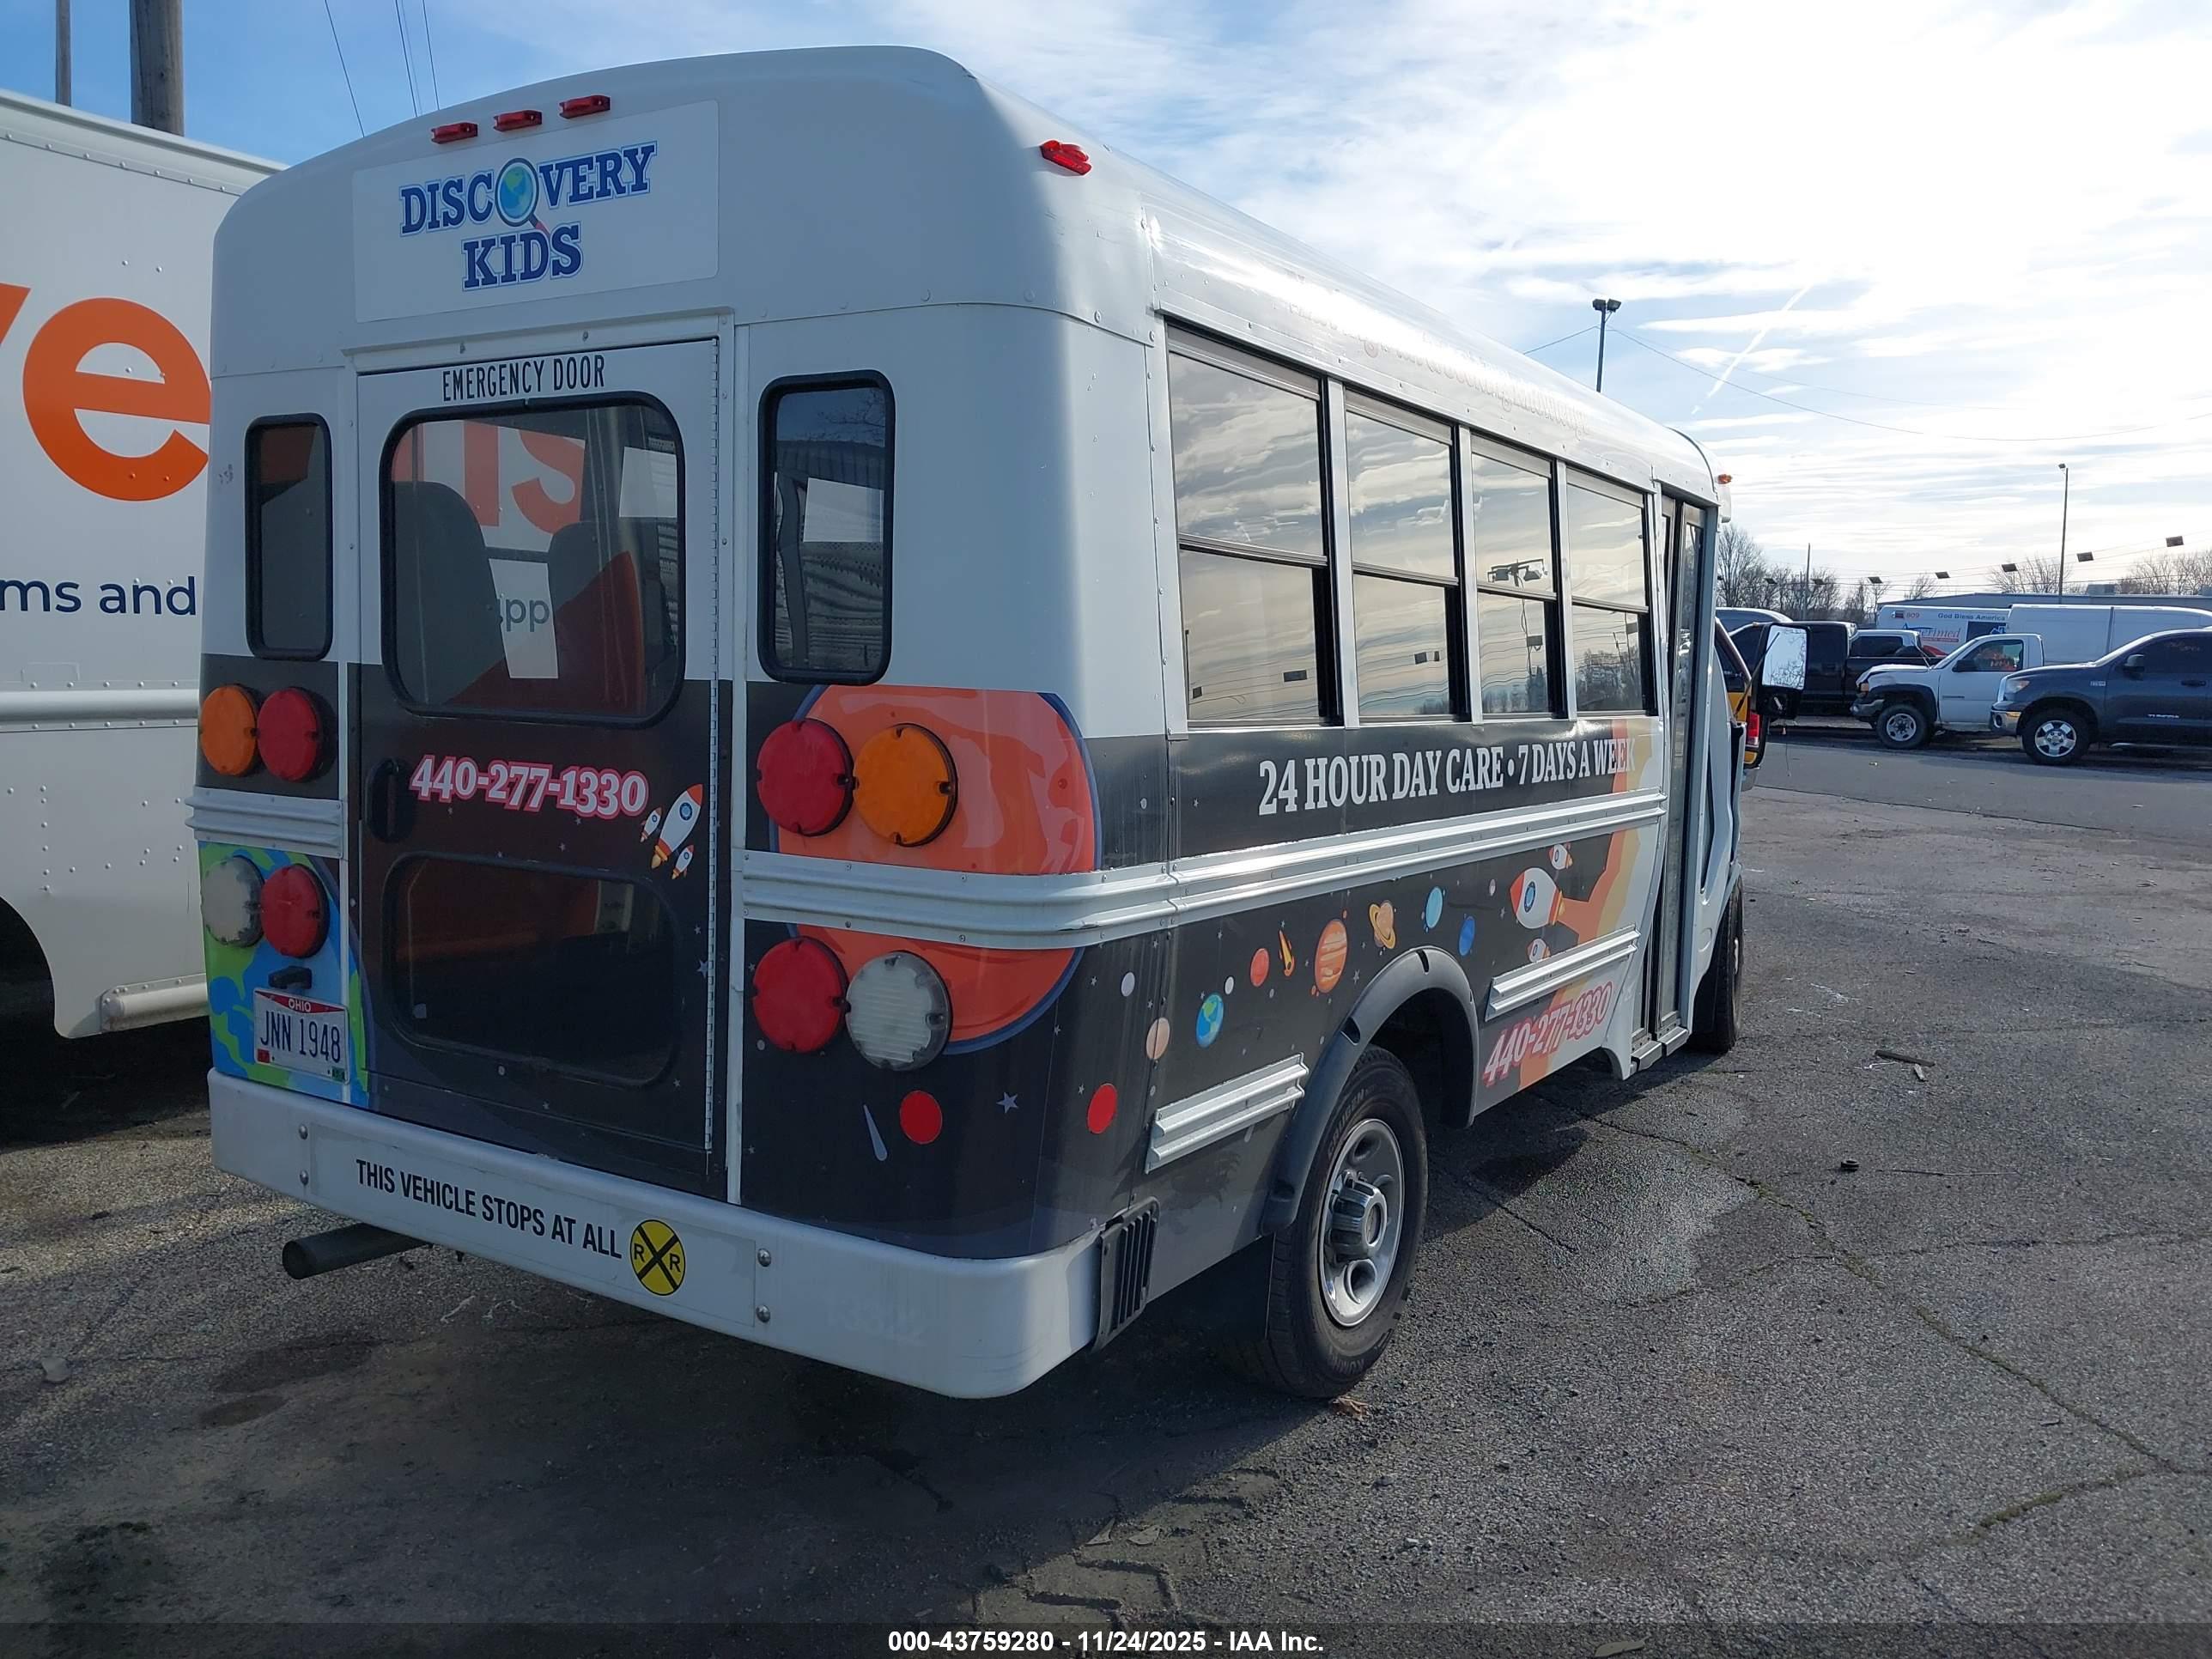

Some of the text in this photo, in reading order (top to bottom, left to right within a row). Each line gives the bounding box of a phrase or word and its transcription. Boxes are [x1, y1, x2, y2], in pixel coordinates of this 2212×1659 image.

[399, 141, 657, 236] DISCOVERY
[461, 222, 584, 291] KIDS
[442, 355, 605, 402] EMERGENCY DOOR
[99, 576, 196, 616] and
[410, 755, 649, 821] 440-277-1330
[1258, 737, 1637, 816] 24 HOUR DAY CARE 7 DAYS A WEEK
[288, 998, 311, 1012] OHIO
[1483, 981, 1613, 1087] 440-277-1330
[259, 1010, 341, 1063] JNN 1948
[356, 1159, 622, 1259] THIS VEHICLE STOPS AT ALL
[633, 1243, 645, 1262] R
[669, 1255, 681, 1273] R
